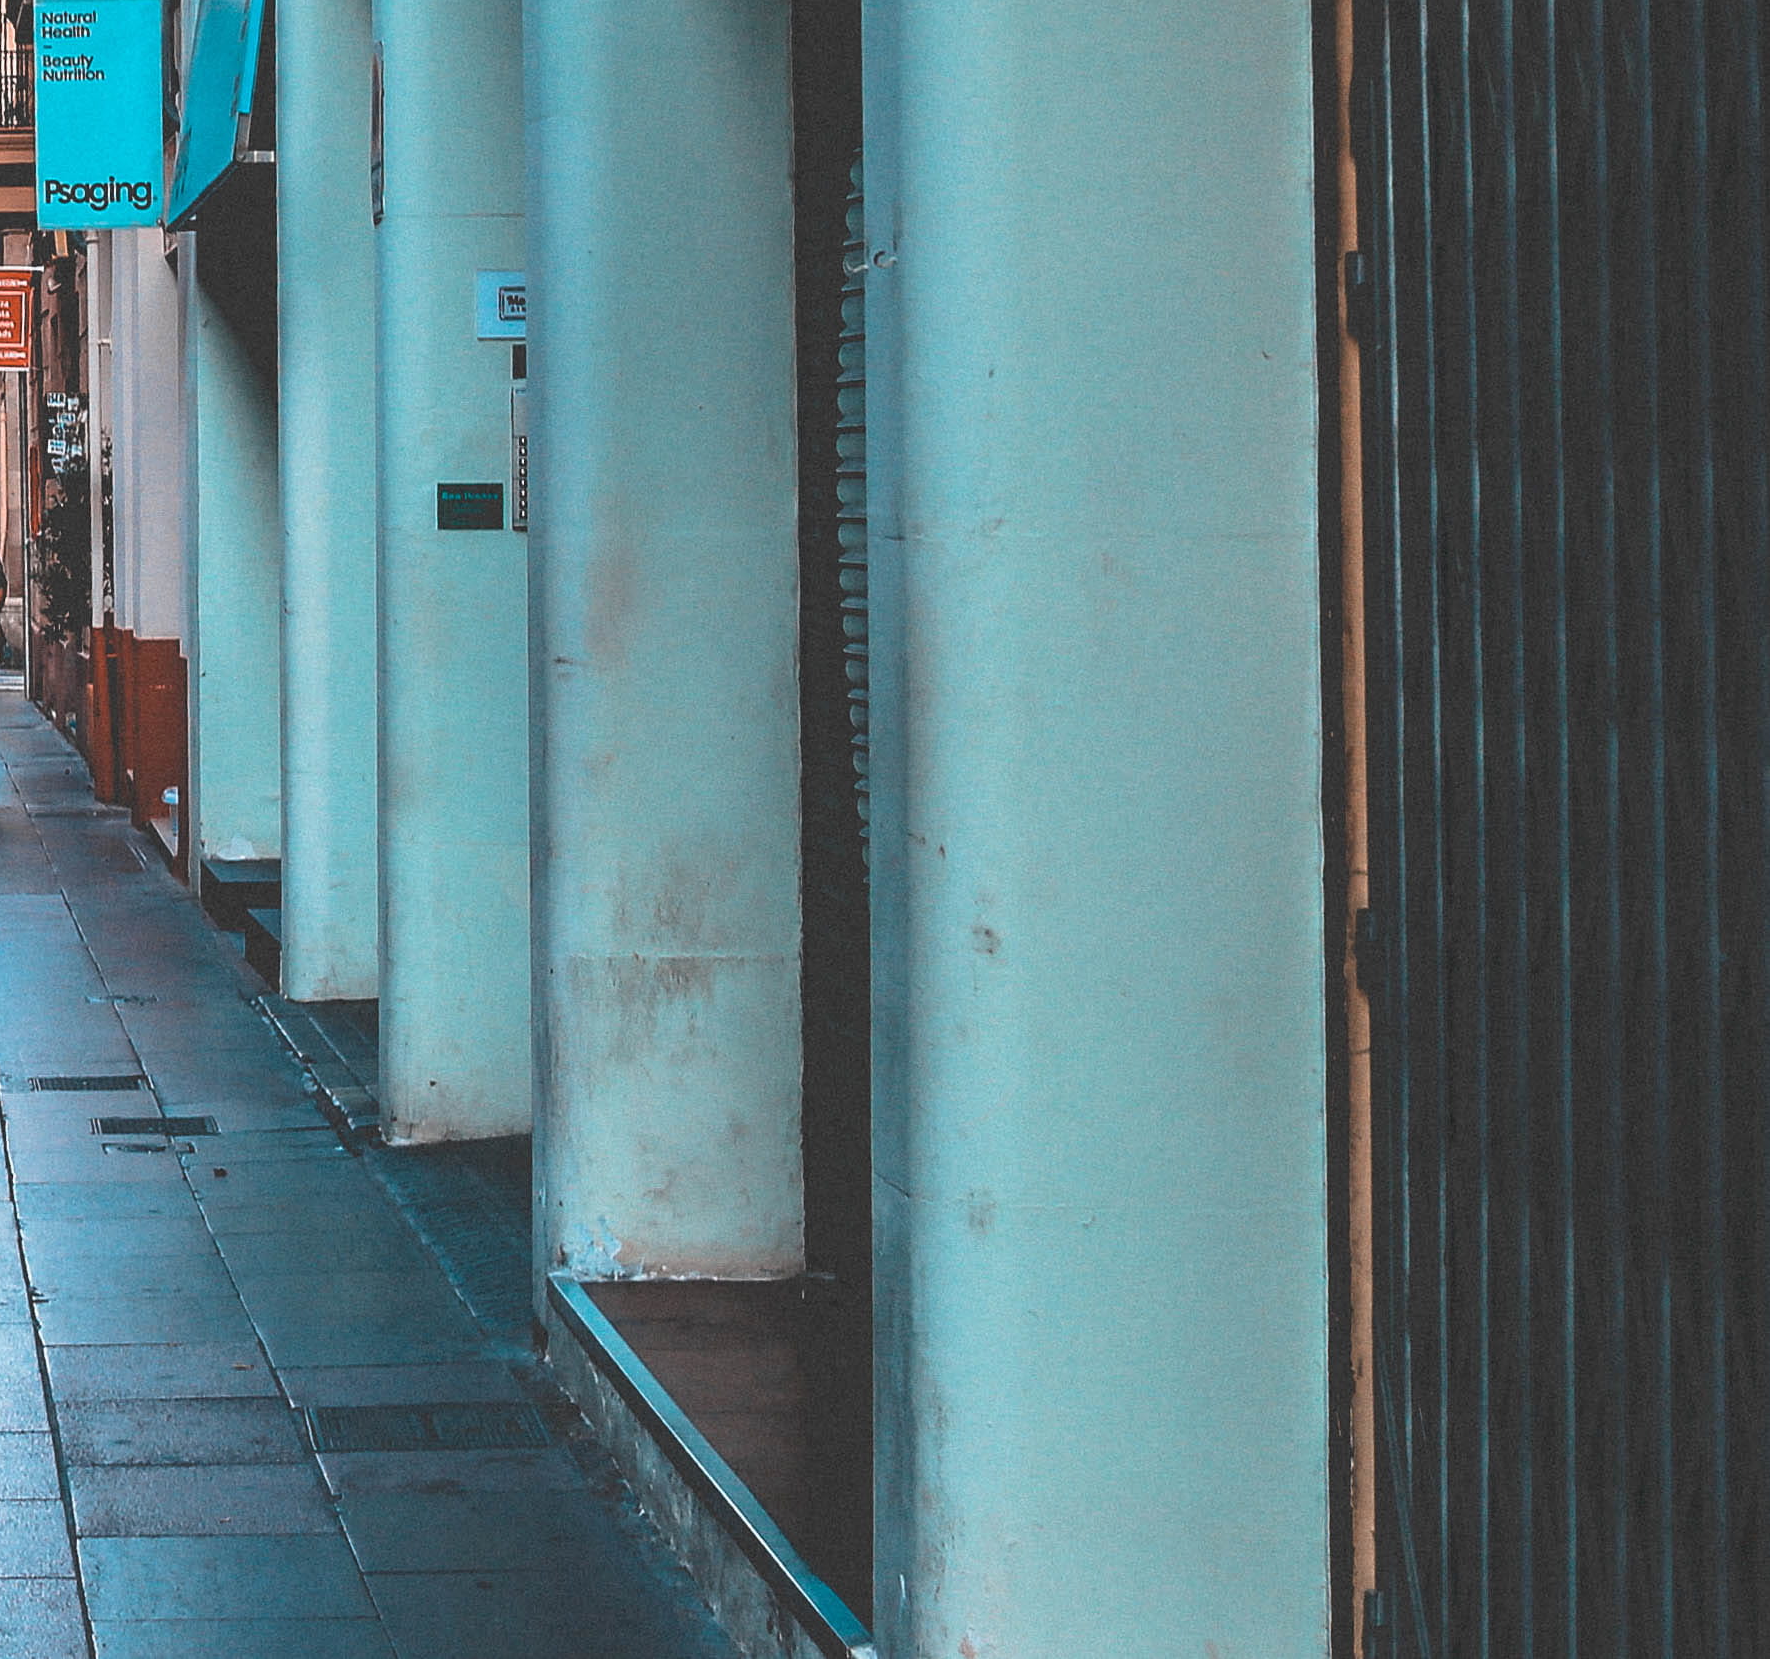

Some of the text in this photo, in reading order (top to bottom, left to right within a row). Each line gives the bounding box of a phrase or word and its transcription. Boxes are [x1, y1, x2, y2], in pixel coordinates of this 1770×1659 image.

[42, 11, 97, 24] Natural
[42, 26, 91, 39] Health
[43, 54, 94, 69] Beauty
[43, 69, 105, 82] Nutrition
[45, 176, 152, 211] Psaging
